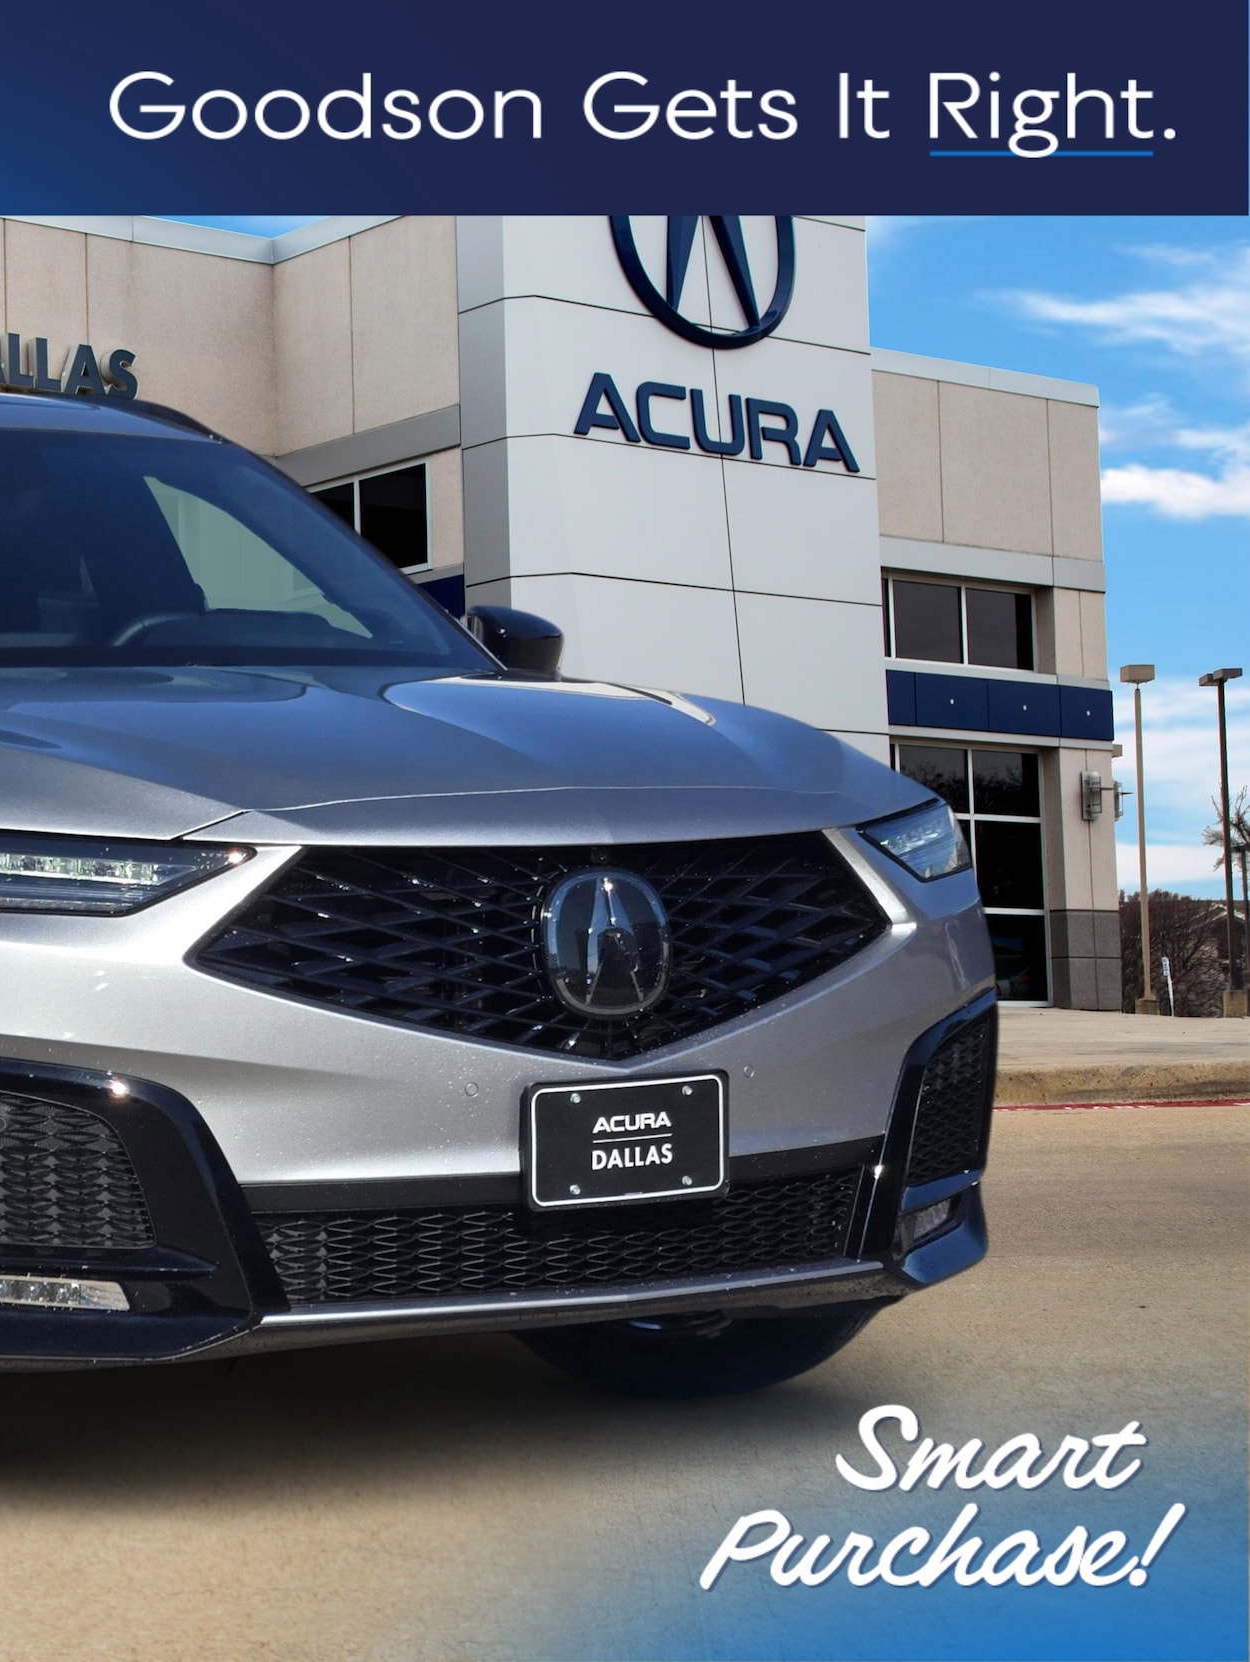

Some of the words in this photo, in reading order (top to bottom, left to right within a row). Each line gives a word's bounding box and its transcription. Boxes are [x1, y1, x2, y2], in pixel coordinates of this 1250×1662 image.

[573, 371, 860, 473] ACURA
[592, 1111, 671, 1134] ACURA
[592, 1143, 673, 1170] DALLAS
